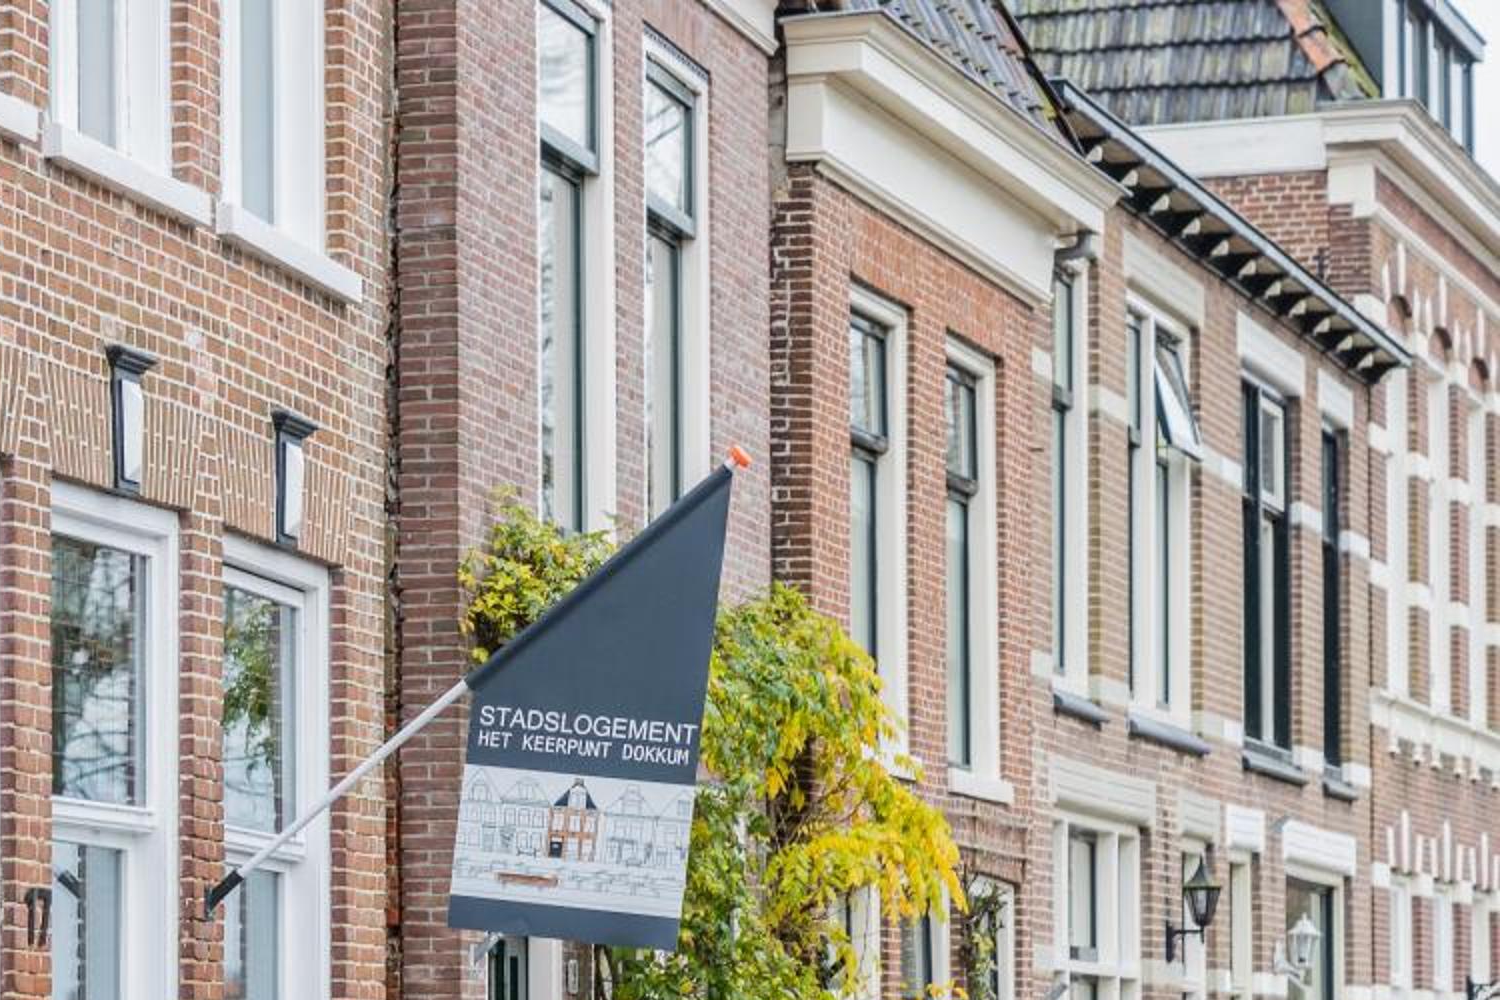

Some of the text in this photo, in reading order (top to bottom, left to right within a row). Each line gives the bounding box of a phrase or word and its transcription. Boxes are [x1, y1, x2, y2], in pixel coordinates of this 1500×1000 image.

[480, 705, 698, 744] STADSLOGEMENT
[478, 729, 689, 765] HET KEERPUNT DOKKUM
